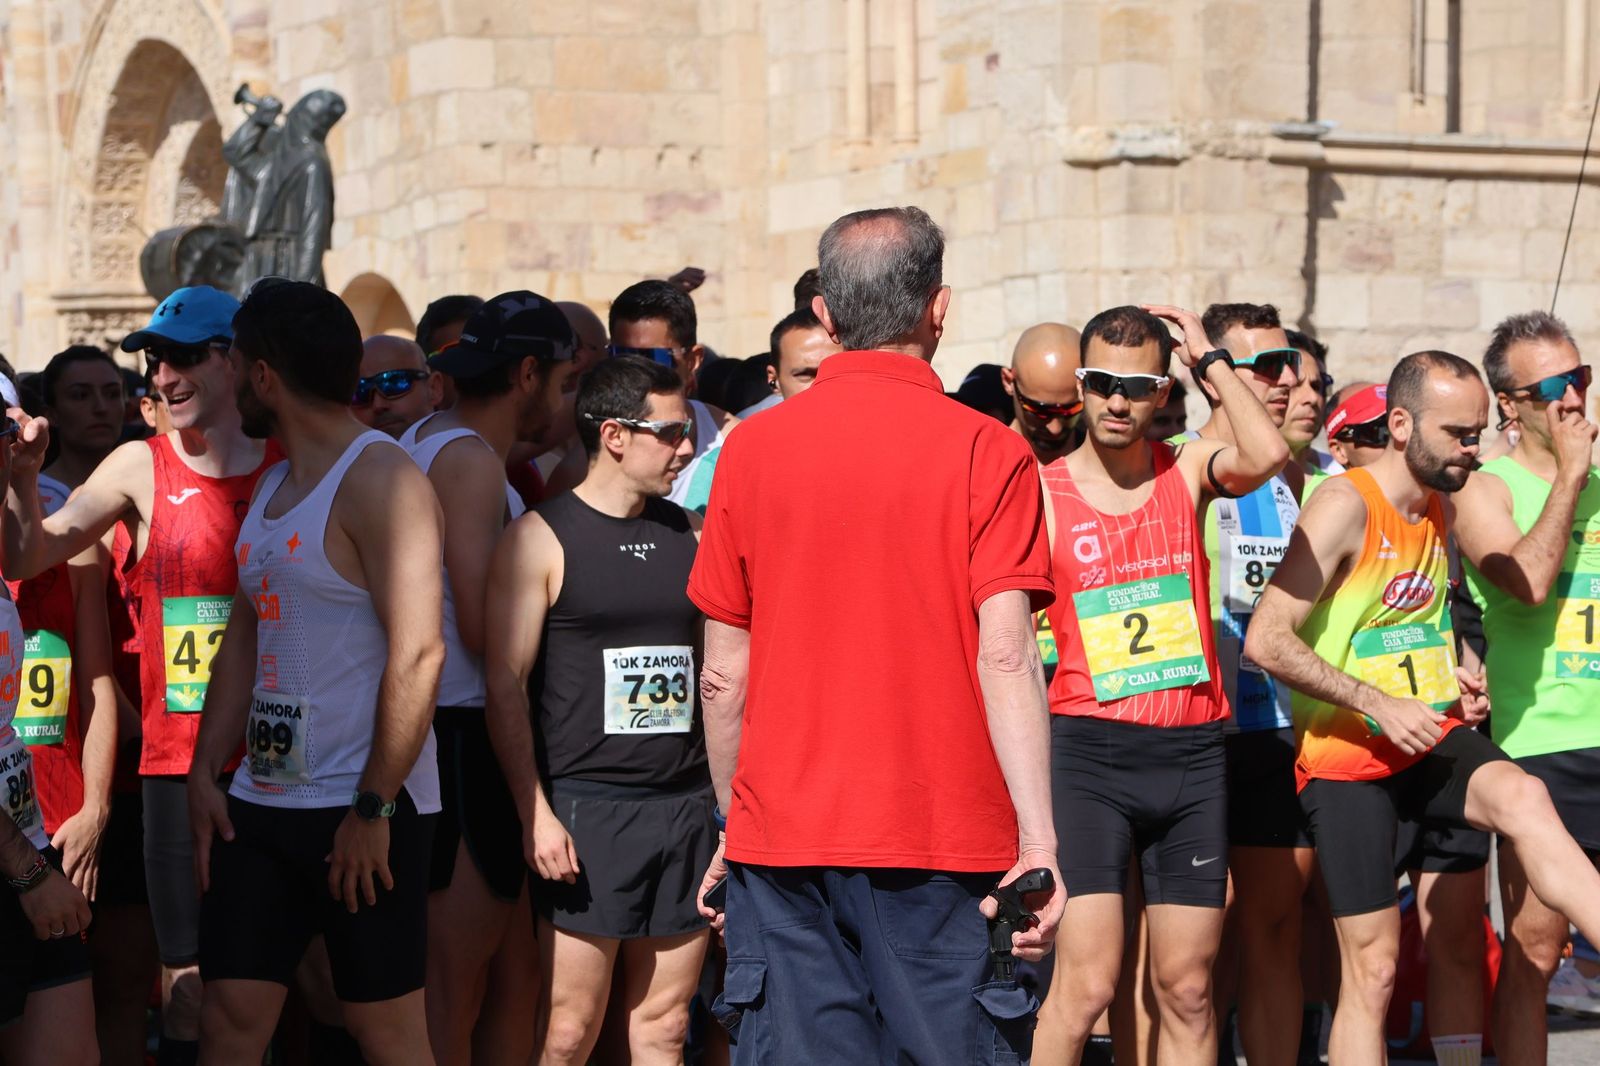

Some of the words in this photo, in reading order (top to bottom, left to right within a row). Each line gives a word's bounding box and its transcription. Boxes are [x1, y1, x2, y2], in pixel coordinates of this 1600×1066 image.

[620, 542, 656, 551] HYROX
[1237, 544, 1258, 555] 10K
[1115, 554, 1168, 574] vistasol
[1108, 595, 1131, 606] CAJA
[1132, 589, 1162, 602] RURAL
[197, 609, 219, 618] CAJA
[1123, 612, 1155, 656] 2
[1384, 637, 1402, 648] CAJA
[612, 655, 639, 669] 10K
[643, 655, 690, 669] ZAMORA
[1128, 672, 1163, 687] CAJA
[1163, 664, 1202, 680] RURAL
[1398, 654, 1418, 696] 1
[29, 664, 55, 708] 9
[623, 672, 688, 704] 733
[256, 699, 302, 720] ZAMORA
[24, 724, 62, 737] RURAL
[650, 718, 671, 728] ZAMORA
